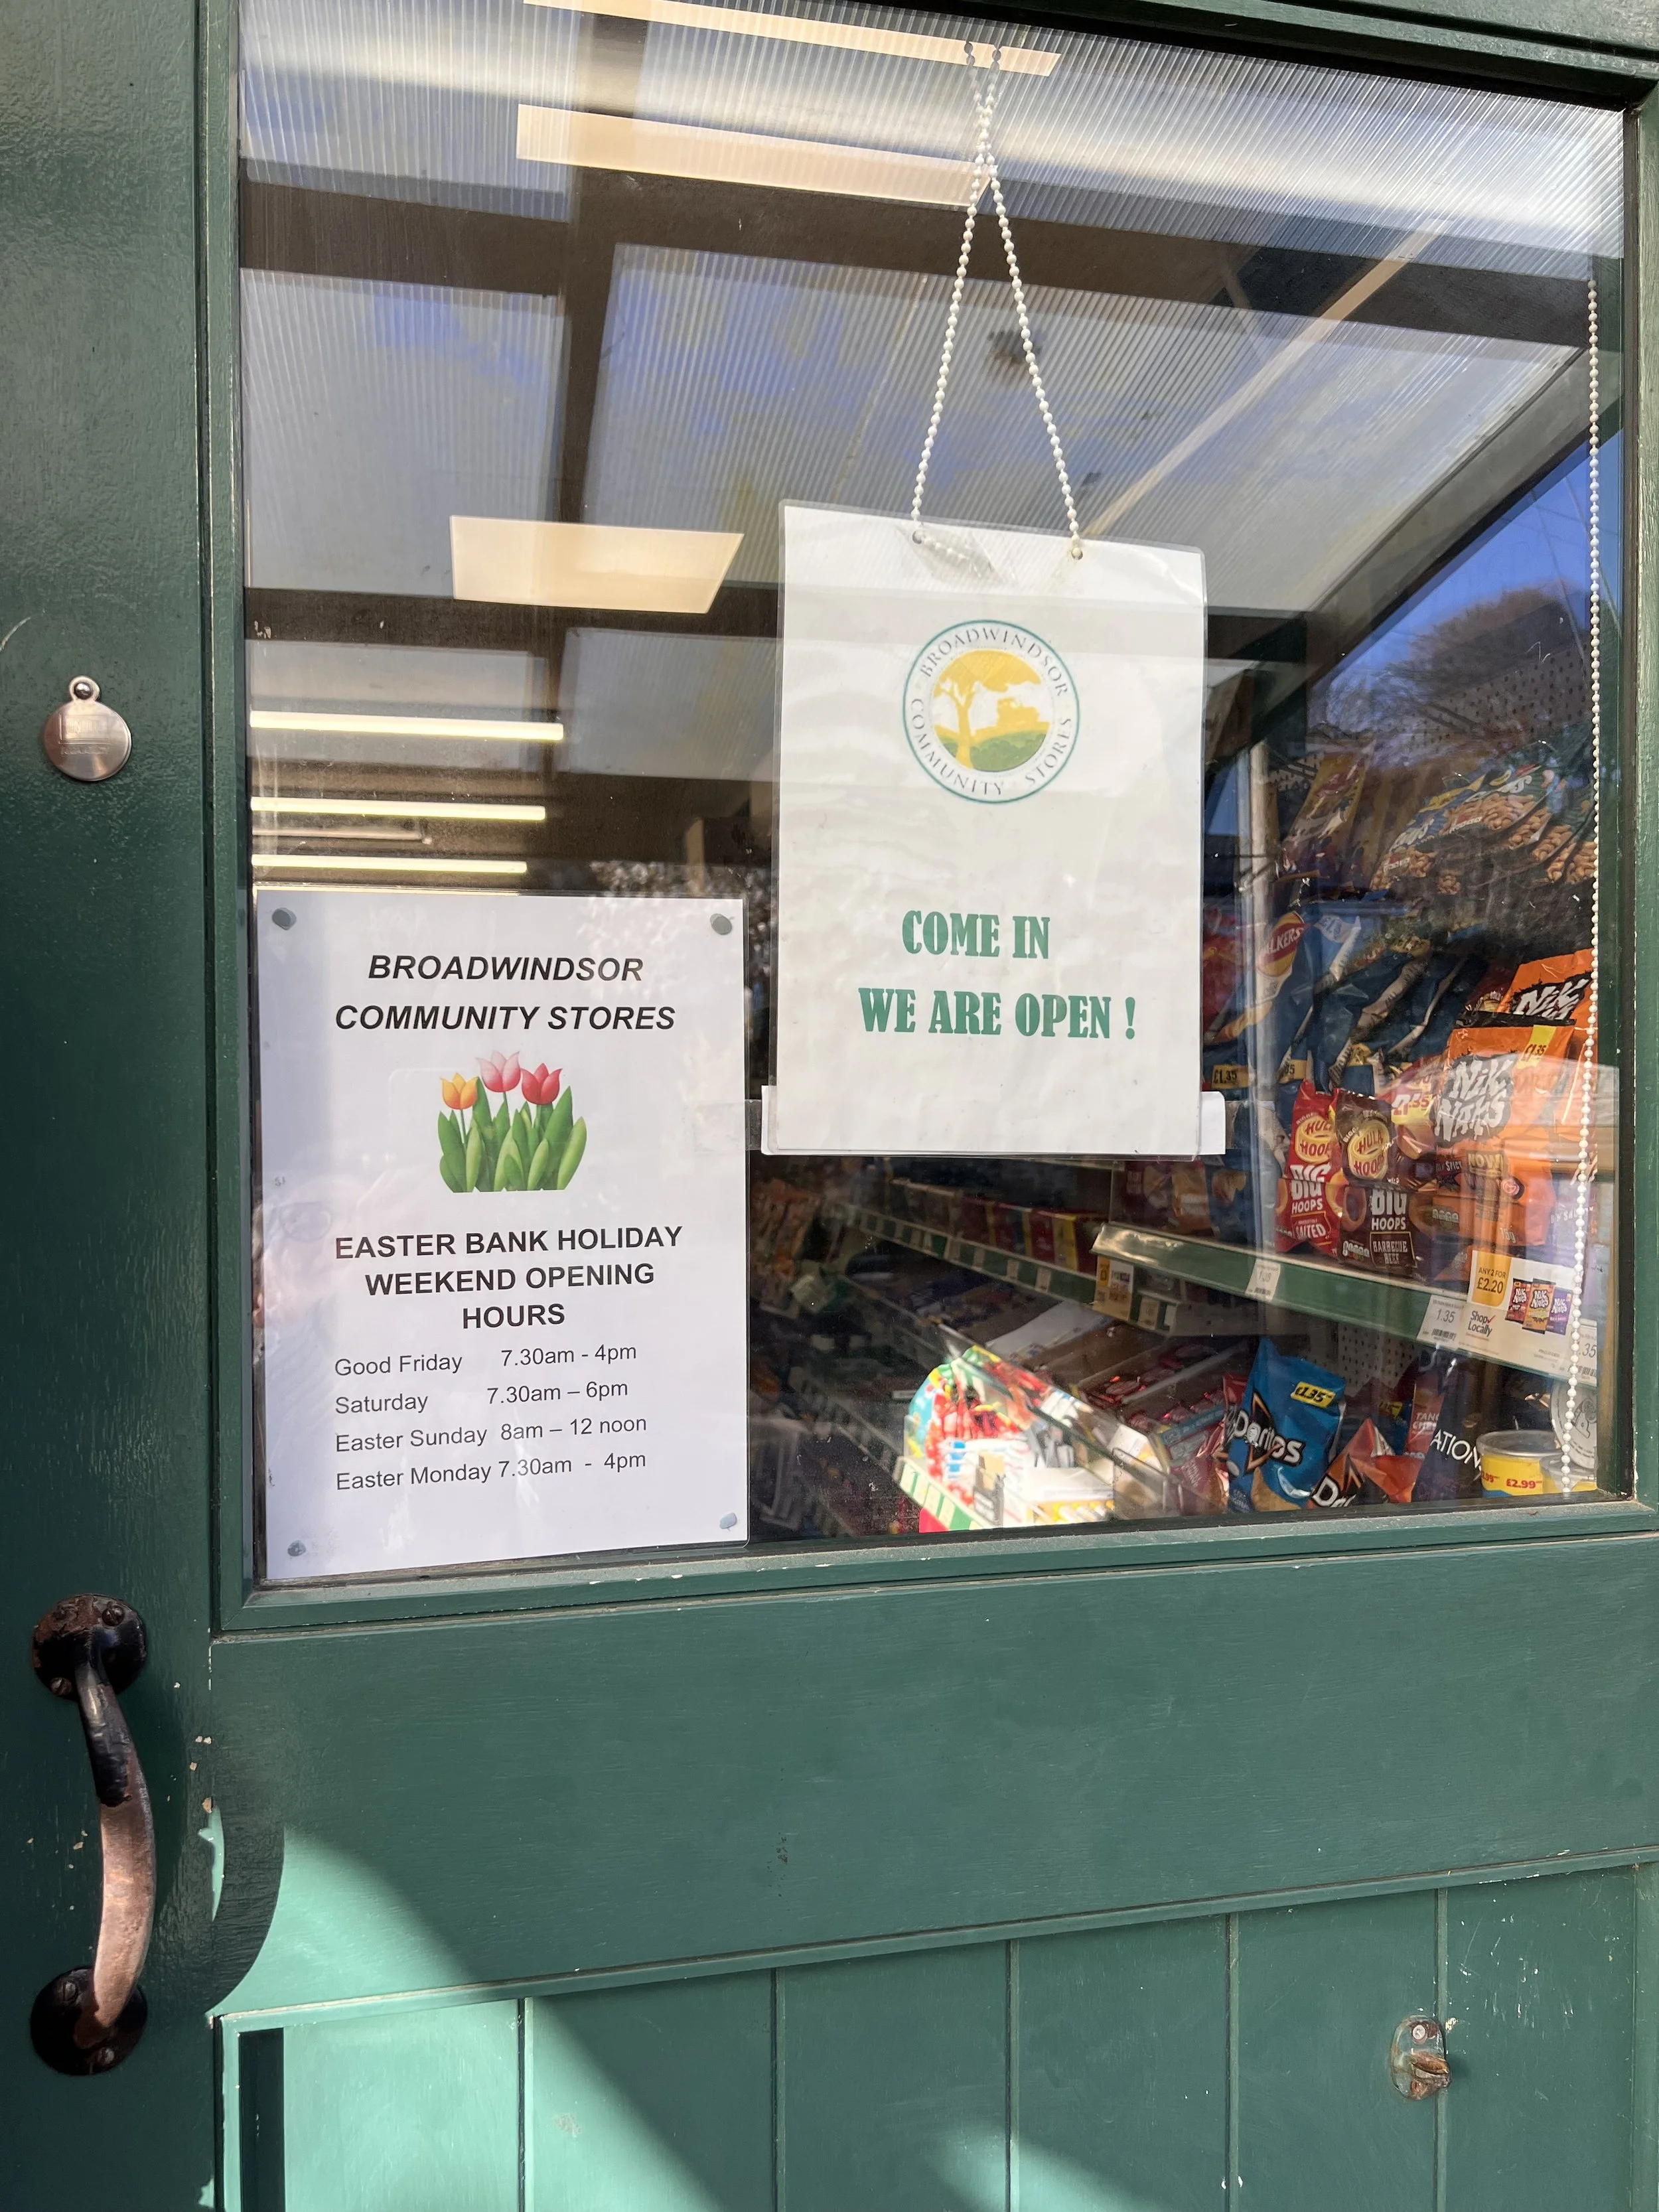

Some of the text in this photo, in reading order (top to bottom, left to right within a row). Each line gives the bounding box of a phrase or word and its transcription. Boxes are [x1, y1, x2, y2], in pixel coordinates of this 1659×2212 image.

[919, 627, 1068, 697] BROADWINDSOR
[910, 698, 1072, 796] COMMUNITY STORES
[902, 910, 1050, 959] COME IN
[368, 954, 644, 982] BROADWINDSOR
[335, 1005, 676, 1030] COMMUNITY STORES
[858, 988, 916, 1033] WE
[928, 990, 1002, 1035] ARE
[1015, 993, 1112, 1039] OPEN
[1291, 1198, 1323, 1215] HOOPS
[1295, 1222, 1327, 1240] SALTED
[1371, 1216, 1407, 1231] HOOPS
[335, 1226, 683, 1260] EASTER BANK HOLIDAY
[1372, 1240, 1409, 1254] BARBECUE
[364, 1262, 654, 1296] WEEKEND OPENING
[1478, 1266, 1491, 1276] ANY
[1494, 1270, 1506, 1279] FOR
[1477, 1278, 1504, 1293] £2.20
[463, 1303, 565, 1329] HOURS
[1436, 1308, 1456, 1323] 1.35
[1470, 1310, 1488, 1324] Shop
[1467, 1321, 1492, 1337] Locally
[334, 1356, 391, 1376] Good
[399, 1353, 463, 1374] Friday
[501, 1348, 575, 1366] 7.30am
[594, 1344, 636, 1365] 4pm
[1575, 1341, 1597, 1359] .35
[335, 1393, 429, 1414] Saturday
[486, 1385, 561, 1404] 7.30am
[586, 1381, 628, 1402] 6pm
[336, 1433, 404, 1452] Easter
[410, 1426, 488, 1447] Sunday
[500, 1423, 543, 1441] 8am
[570, 1418, 593, 1436] 12
[599, 1418, 646, 1434] noon
[336, 1470, 404, 1491] Easter
[411, 1463, 492, 1485] Monday
[498, 1458, 572, 1478] 7.30am
[603, 1452, 646, 1473] 4pm
[1506, 1478, 1536, 1489] £2.99
